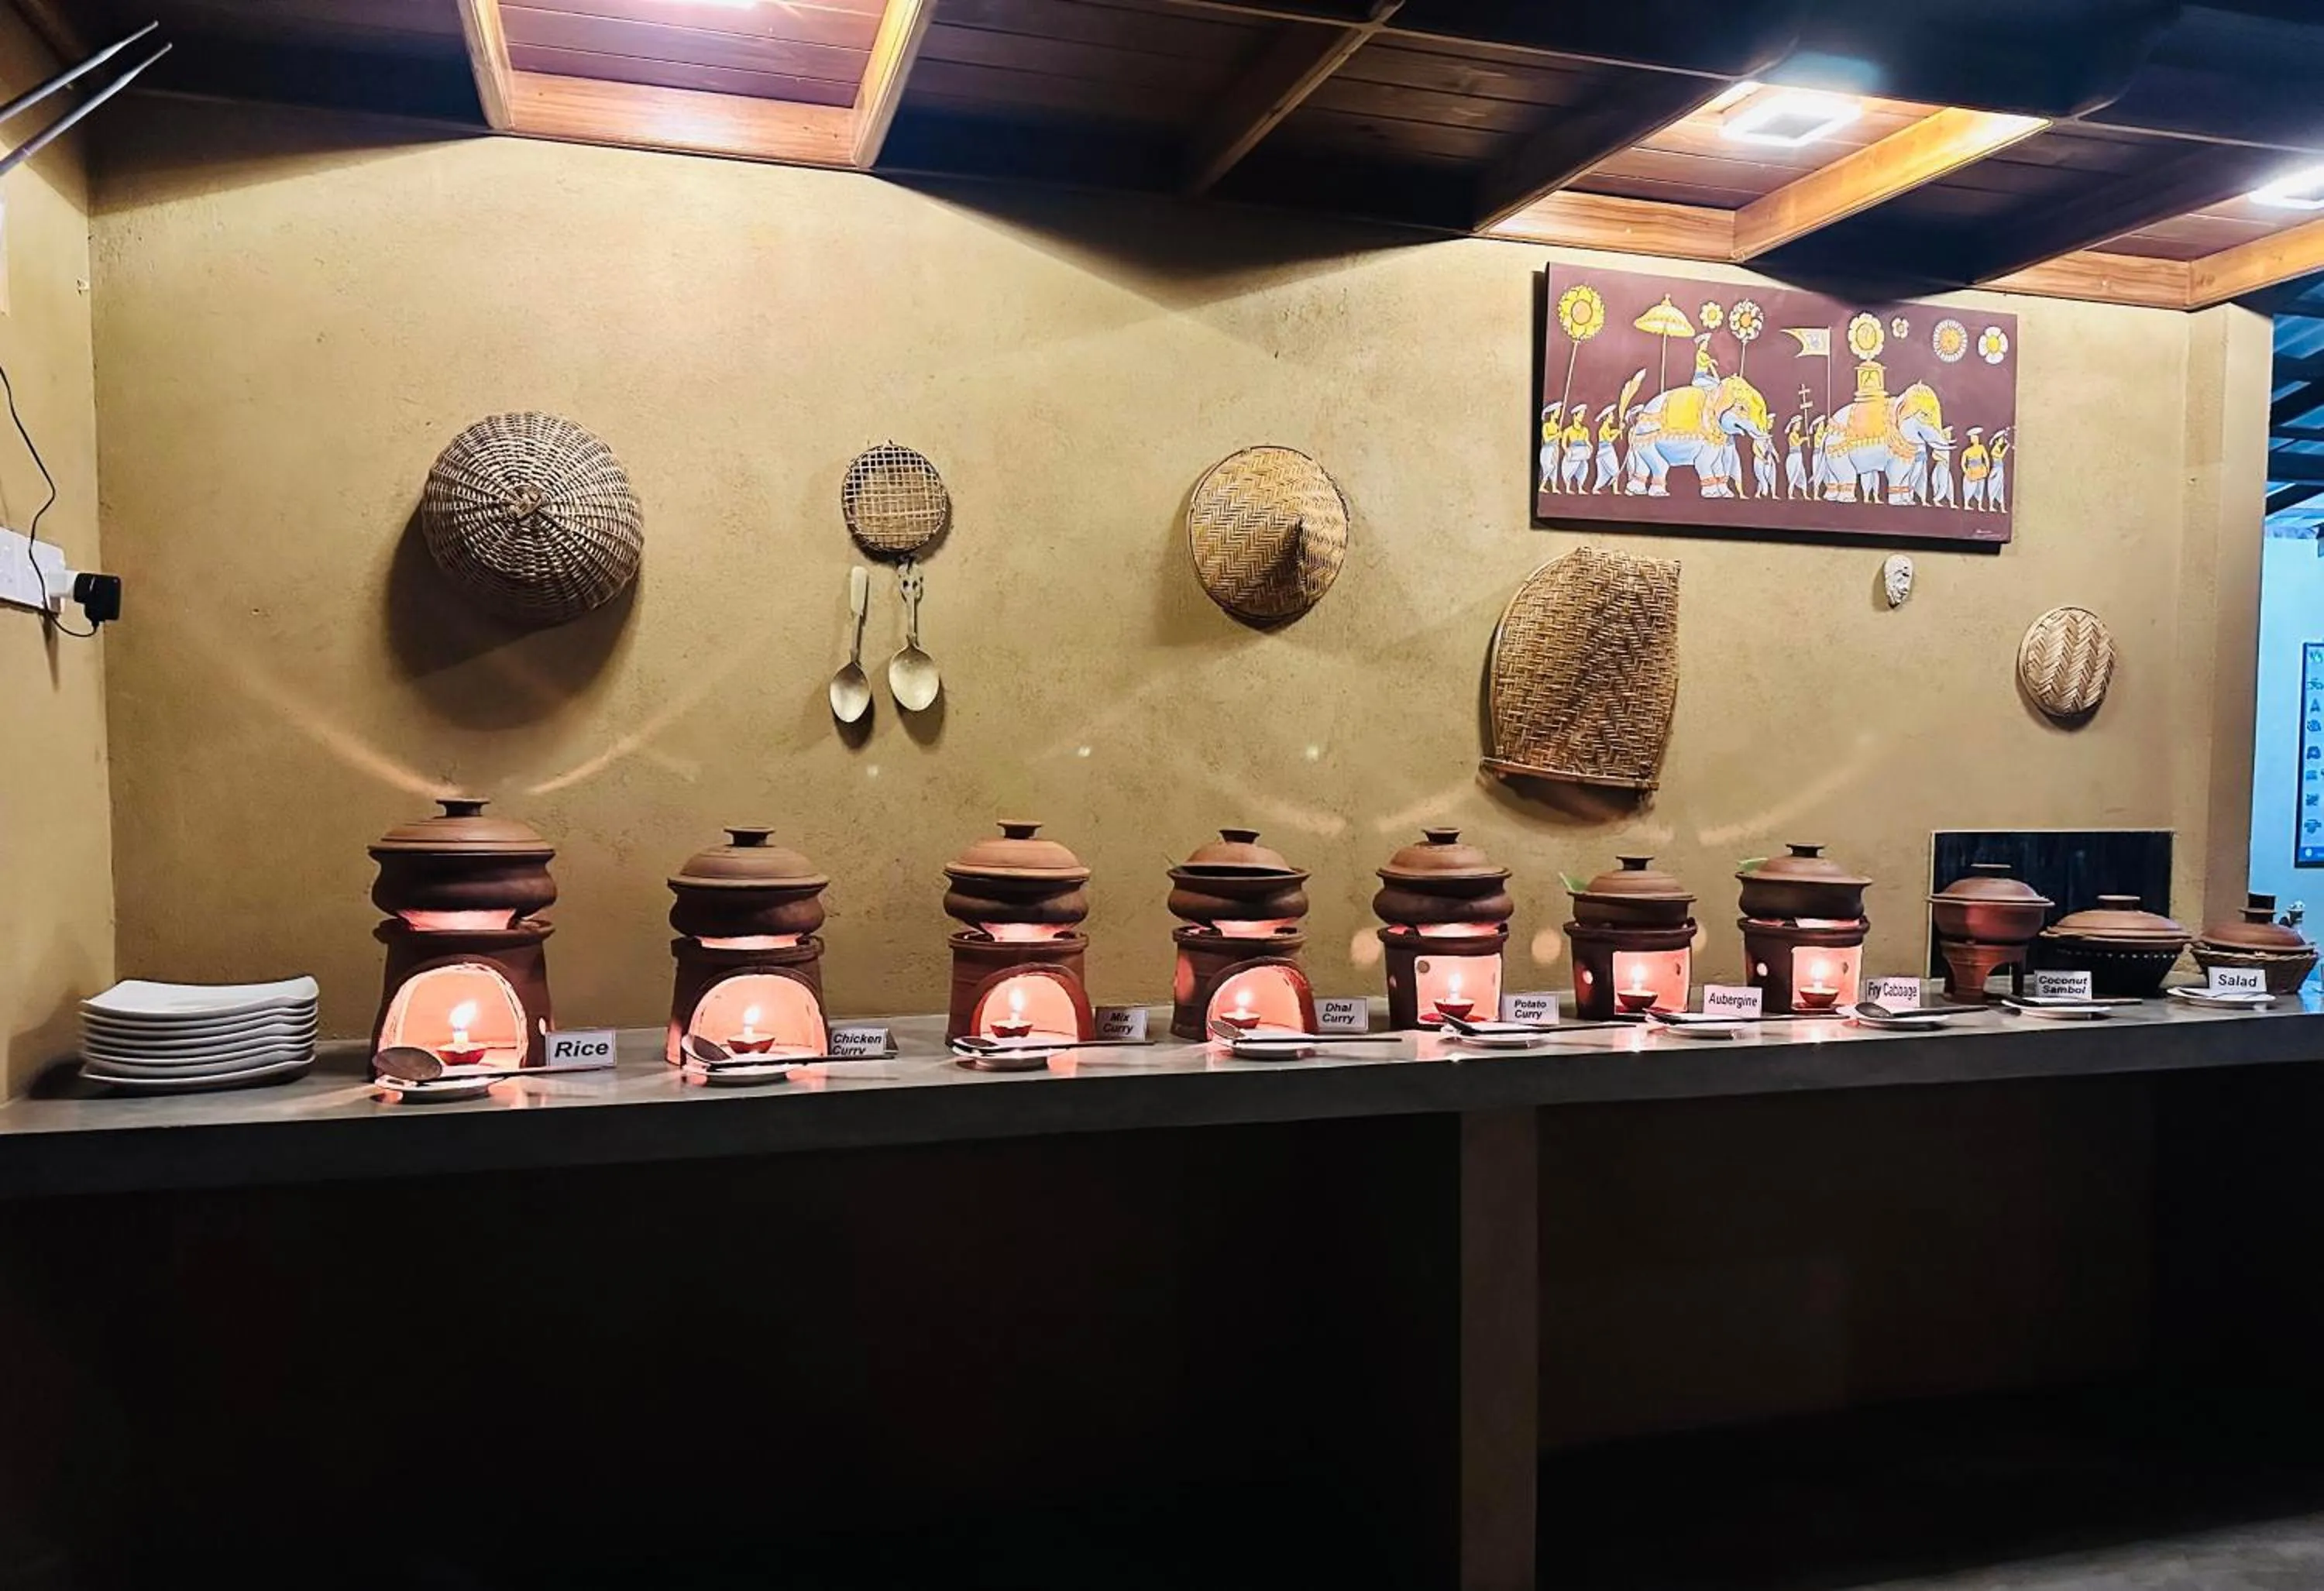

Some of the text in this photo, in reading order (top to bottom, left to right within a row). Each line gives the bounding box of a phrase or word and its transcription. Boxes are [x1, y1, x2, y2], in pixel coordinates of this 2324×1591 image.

[2038, 975, 2088, 984] Coconut
[2218, 974, 2257, 988] Salad
[1868, 981, 1882, 1000] Fry
[2042, 984, 2086, 994] Sambol
[1514, 999, 1547, 1009] Potato
[1708, 992, 1758, 1009] Aubergine
[1325, 1002, 1353, 1012] Dhal
[1110, 1012, 1129, 1022] Mix
[1322, 1012, 1355, 1025] Curry
[1514, 1009, 1542, 1020] Curry
[1102, 1022, 1133, 1035] Curry
[834, 1033, 882, 1044] Chicken
[555, 1040, 609, 1058] Rice
[832, 1045, 866, 1055] Curry
